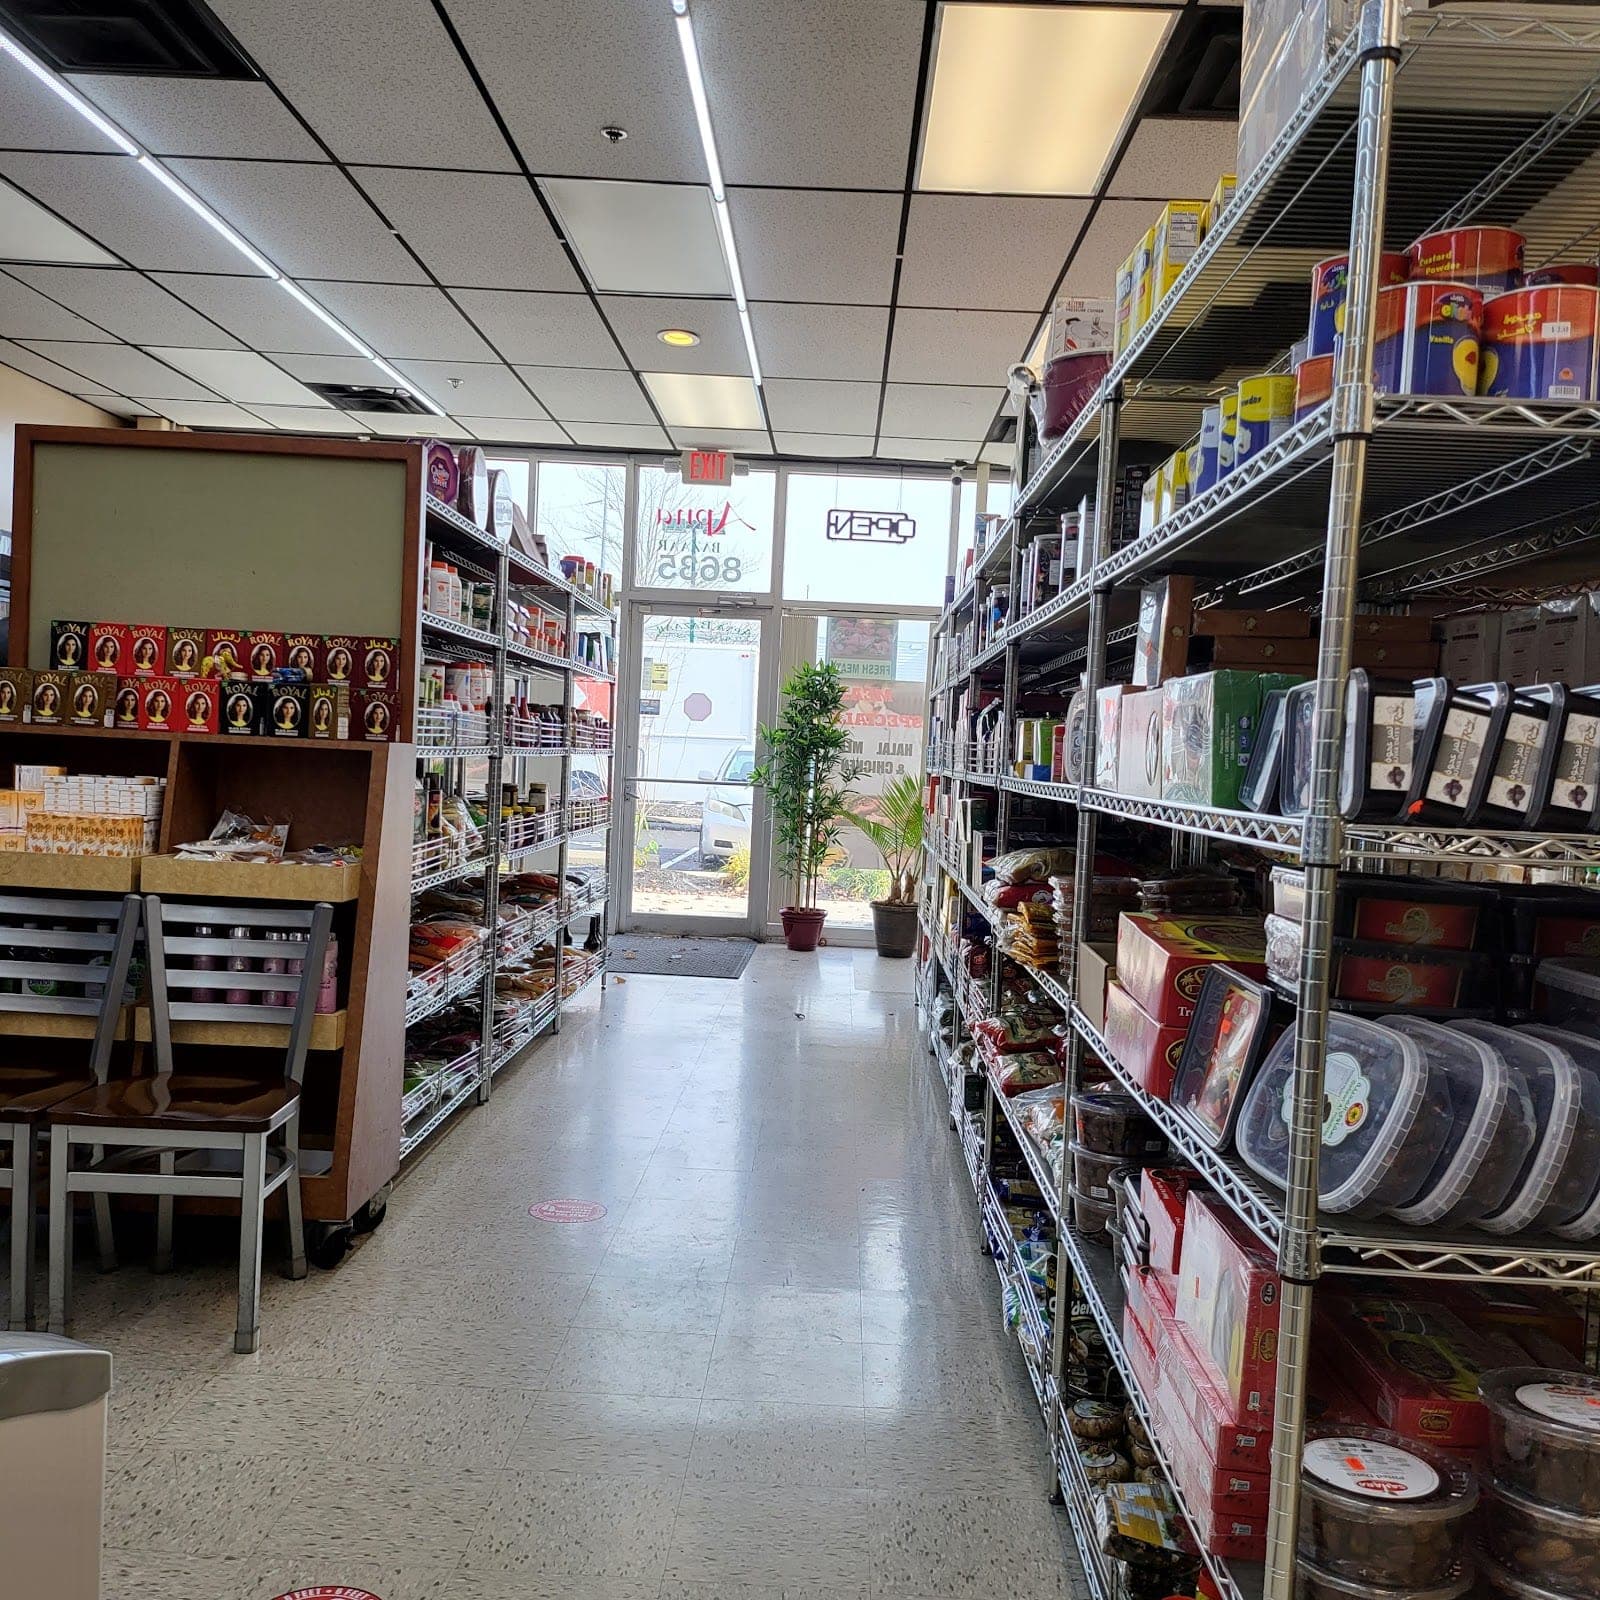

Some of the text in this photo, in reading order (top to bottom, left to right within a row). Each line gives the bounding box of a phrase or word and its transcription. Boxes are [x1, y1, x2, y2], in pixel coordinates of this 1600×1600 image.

[1419, 250, 1452, 267] Custard
[1425, 262, 1461, 276] Powder
[1429, 335, 1454, 345] Vanilla
[690, 452, 727, 481] EXIT
[56, 623, 87, 637] ROYAL
[93, 624, 126, 638] ROYAL
[131, 626, 165, 641] ROYAL
[172, 628, 205, 642] ROYAL
[212, 631, 241, 643] رويال
[249, 633, 282, 647] ROYAL
[287, 636, 320, 648] ROYAL
[325, 637, 359, 650] ROYAL
[364, 639, 395, 652] رويال
[74, 674, 105, 688] ROYAL
[143, 681, 178, 693] ROYAL
[184, 682, 219, 694] ROYAL
[225, 683, 259, 697] ROYAL
[272, 685, 307, 698] ROYAL
[363, 690, 396, 704] ROYAL
